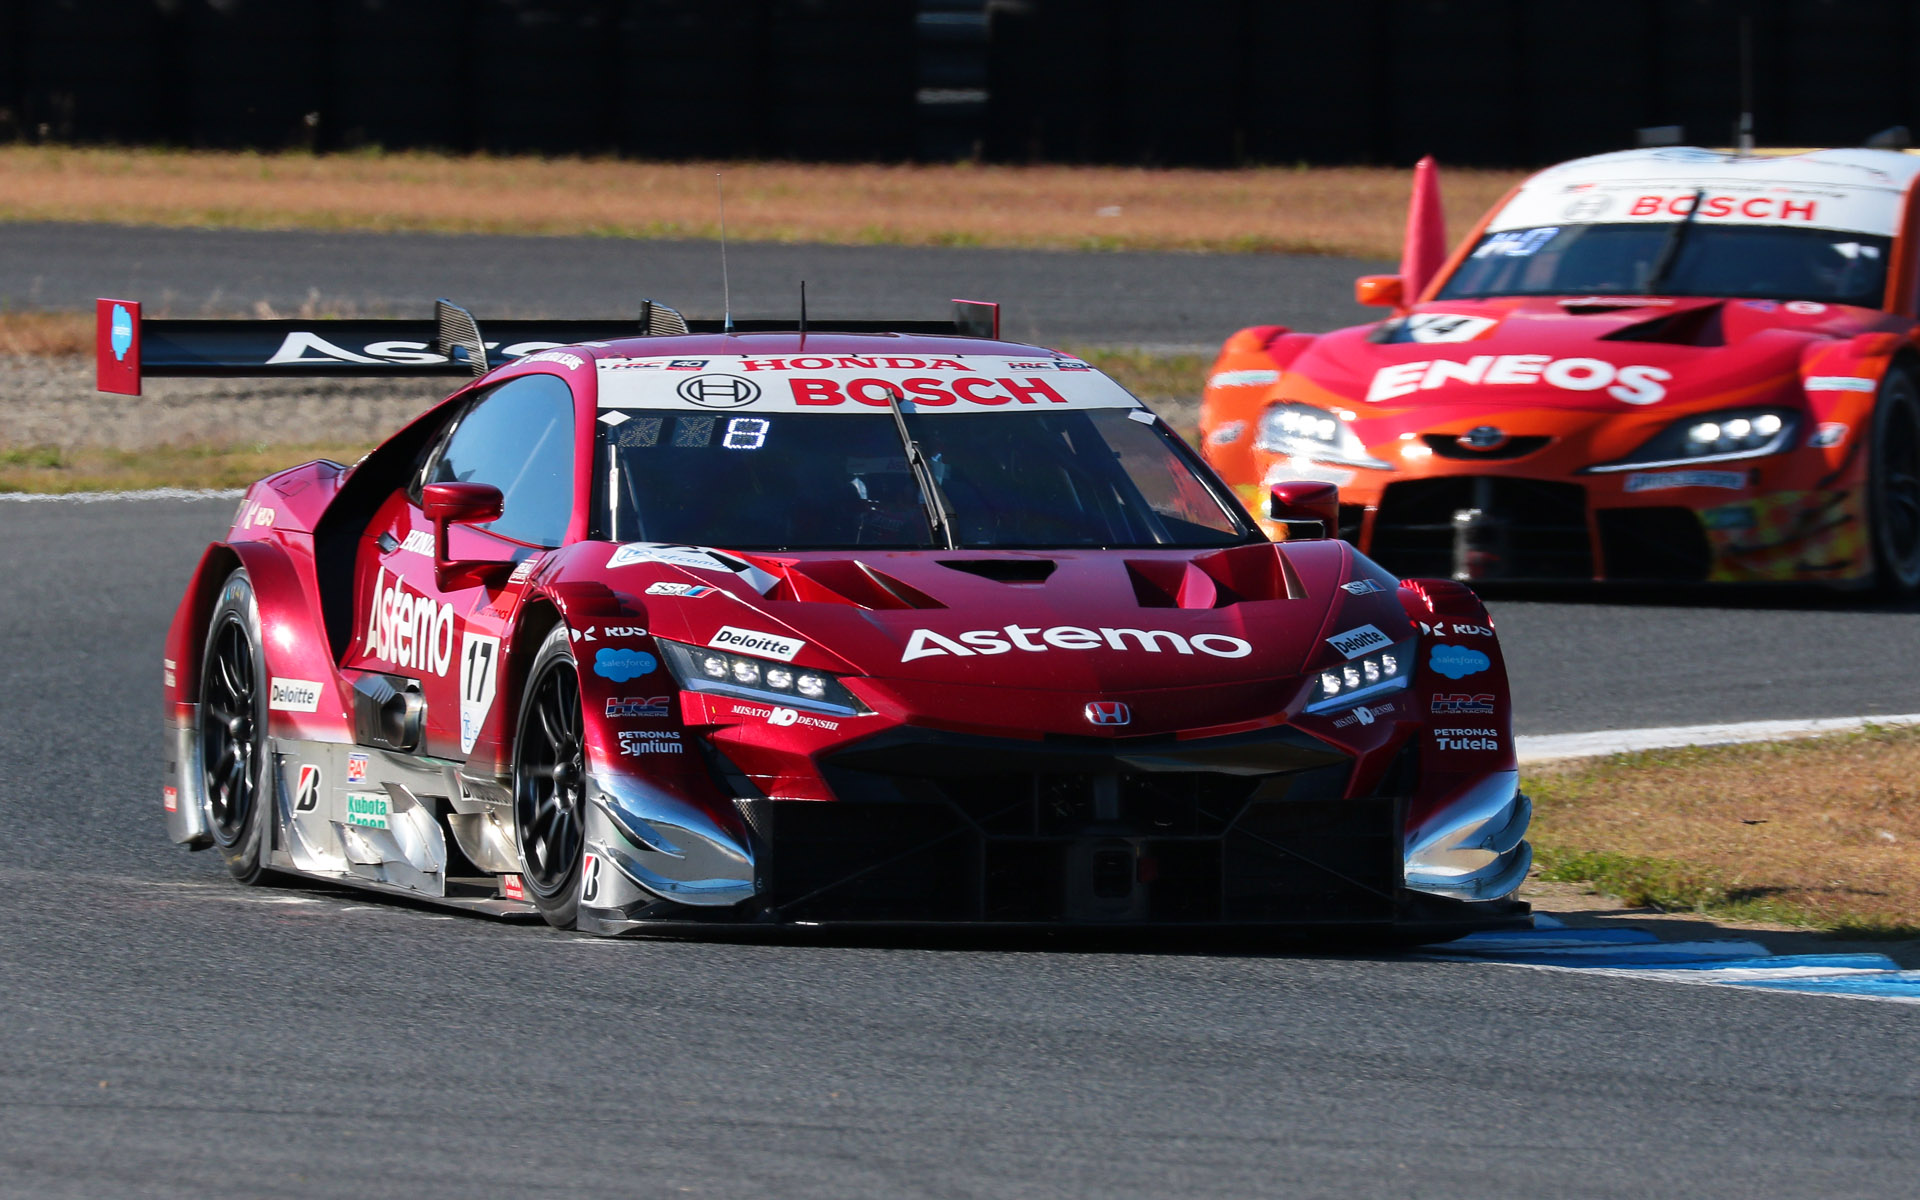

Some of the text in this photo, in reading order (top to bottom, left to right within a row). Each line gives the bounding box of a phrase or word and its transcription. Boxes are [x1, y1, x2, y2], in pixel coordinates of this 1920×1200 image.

[1629, 195, 1817, 222] BOSCH
[738, 356, 976, 372] HONDA
[1366, 354, 1672, 405] ENEOS
[789, 377, 1068, 406] BOSCH
[362, 566, 454, 677] Astemo
[901, 624, 1252, 662] Astemo
[602, 659, 650, 668] salesforce
[1436, 656, 1484, 664] salesforce
[467, 640, 492, 702] 17
[606, 696, 670, 714] HRC
[1431, 694, 1495, 711] HRC
[731, 705, 770, 718] MISATO
[797, 716, 839, 730] DENSHI
[1333, 714, 1359, 729] MISATO
[1371, 703, 1395, 717] DENSHI
[618, 731, 680, 739] PETRONAS
[1437, 737, 1498, 750] Tutela
[620, 739, 683, 756] Syntium
[348, 796, 386, 815] Kubota
